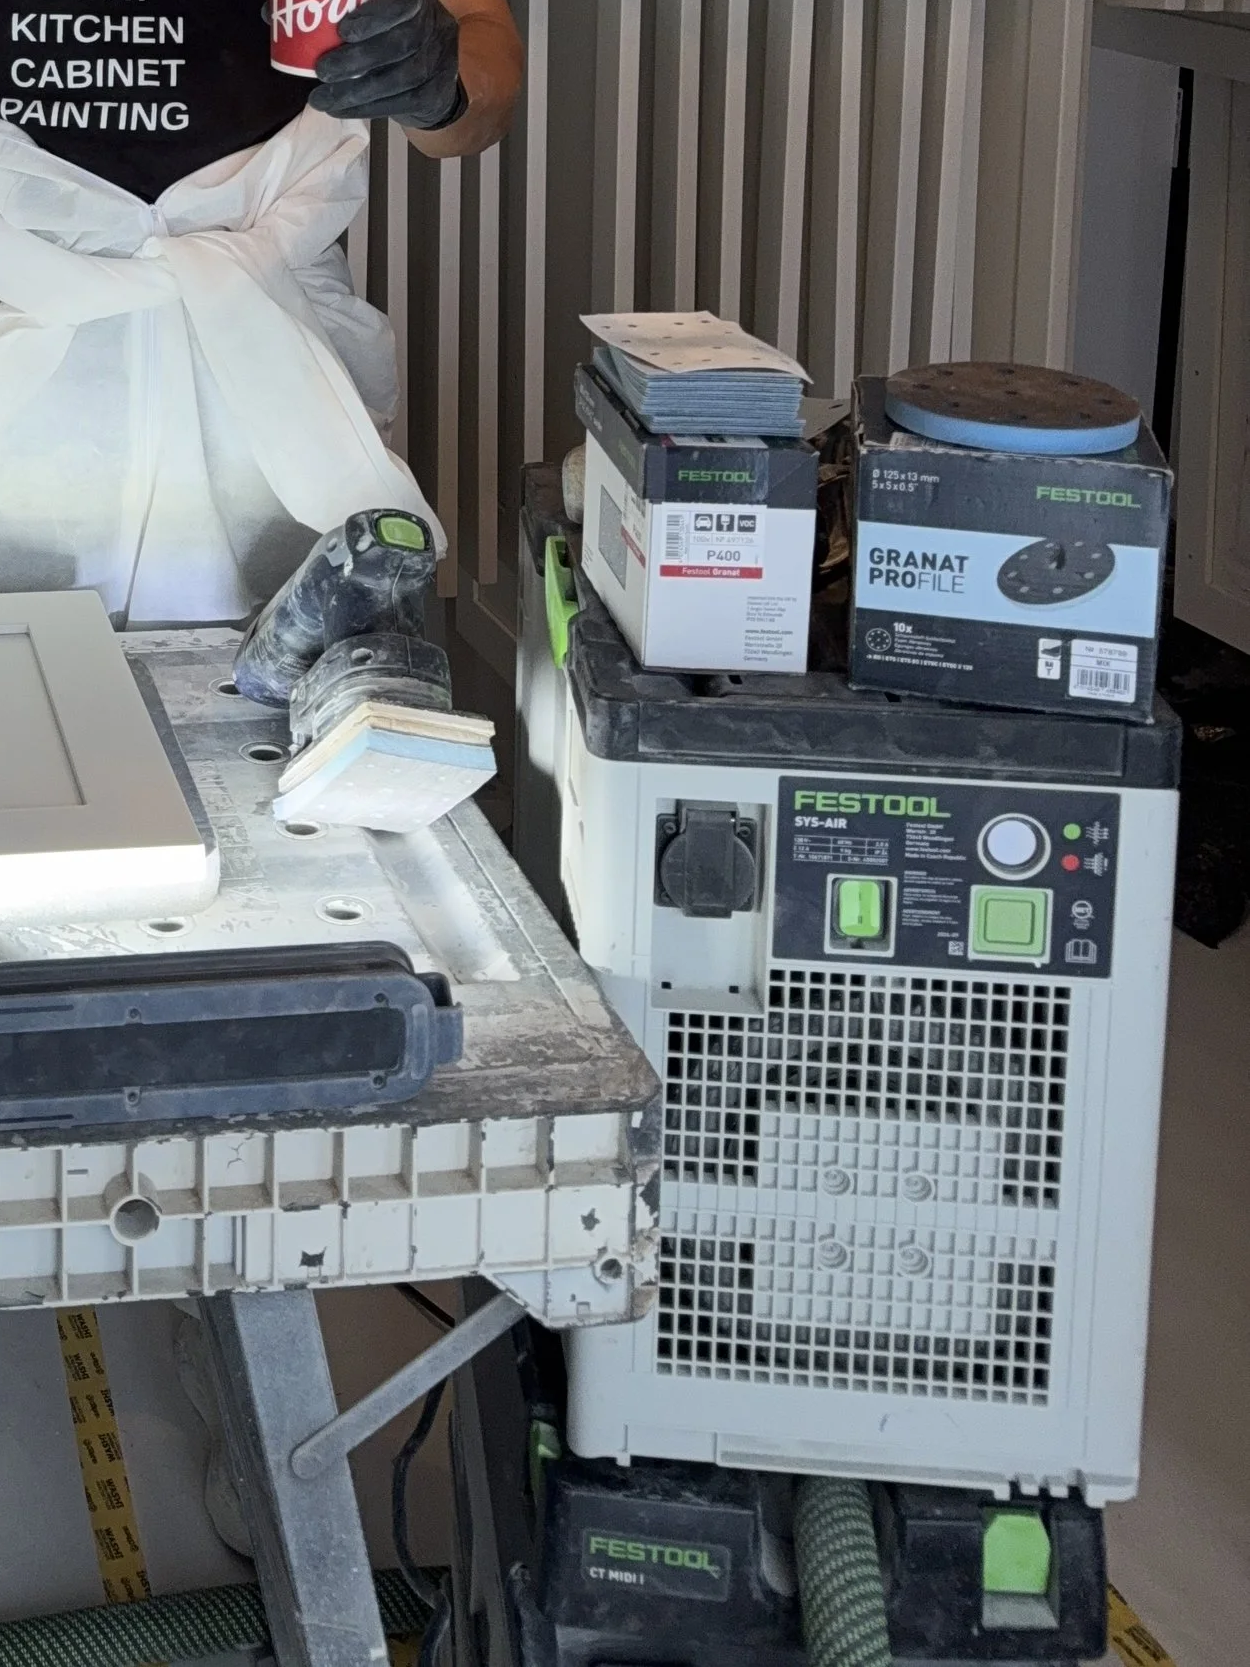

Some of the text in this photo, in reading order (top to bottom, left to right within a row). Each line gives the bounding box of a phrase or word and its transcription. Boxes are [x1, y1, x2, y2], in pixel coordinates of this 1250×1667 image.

[10, 13, 184, 45] KITCHEN
[10, 58, 186, 89] CABINET
[0, 97, 189, 132] PAINTING
[678, 470, 755, 483] FESTOOL
[920, 474, 940, 483] mm
[1036, 486, 1141, 509] FESTOOL
[707, 550, 741, 562] P400
[869, 547, 969, 573] GRANAT
[682, 567, 741, 576] Festool Granat
[869, 567, 965, 594] PROFILE
[893, 622, 913, 633] 10x
[793, 790, 951, 818] FESTOOL
[794, 816, 848, 829] SYS-AIR
[77, 1313, 93, 1339] WASHI
[73, 1353, 90, 1380] WASHI
[98, 1434, 116, 1463] WASHI
[105, 1478, 124, 1509] WASHI
[103, 1527, 124, 1559] WASHI
[589, 1536, 710, 1570] FESTOOL
[589, 1567, 606, 1579] CT
[608, 1569, 637, 1584] MIDI
